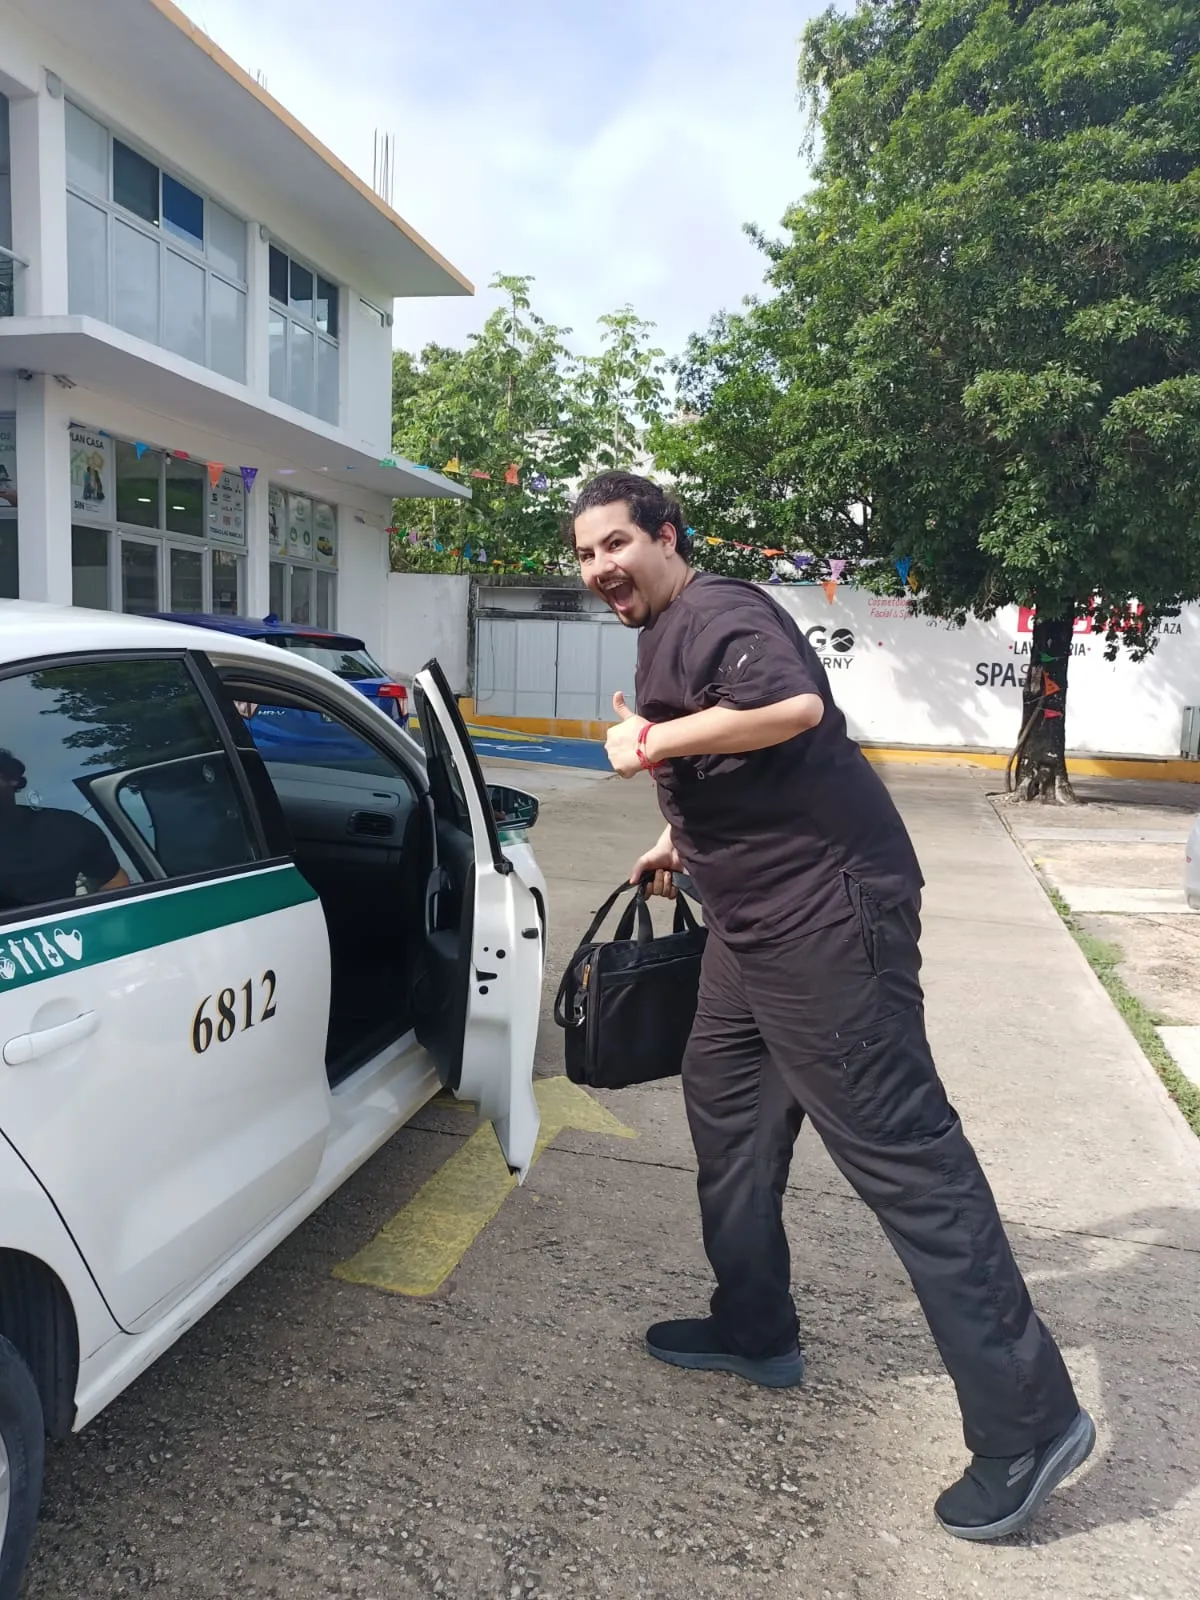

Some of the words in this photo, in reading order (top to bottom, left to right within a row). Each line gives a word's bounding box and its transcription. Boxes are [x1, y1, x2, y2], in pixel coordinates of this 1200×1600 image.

[86, 436, 105, 450] CASA
[74, 500, 85, 511] SIN
[870, 608, 893, 618] Facial
[191, 968, 278, 1055] 6812
